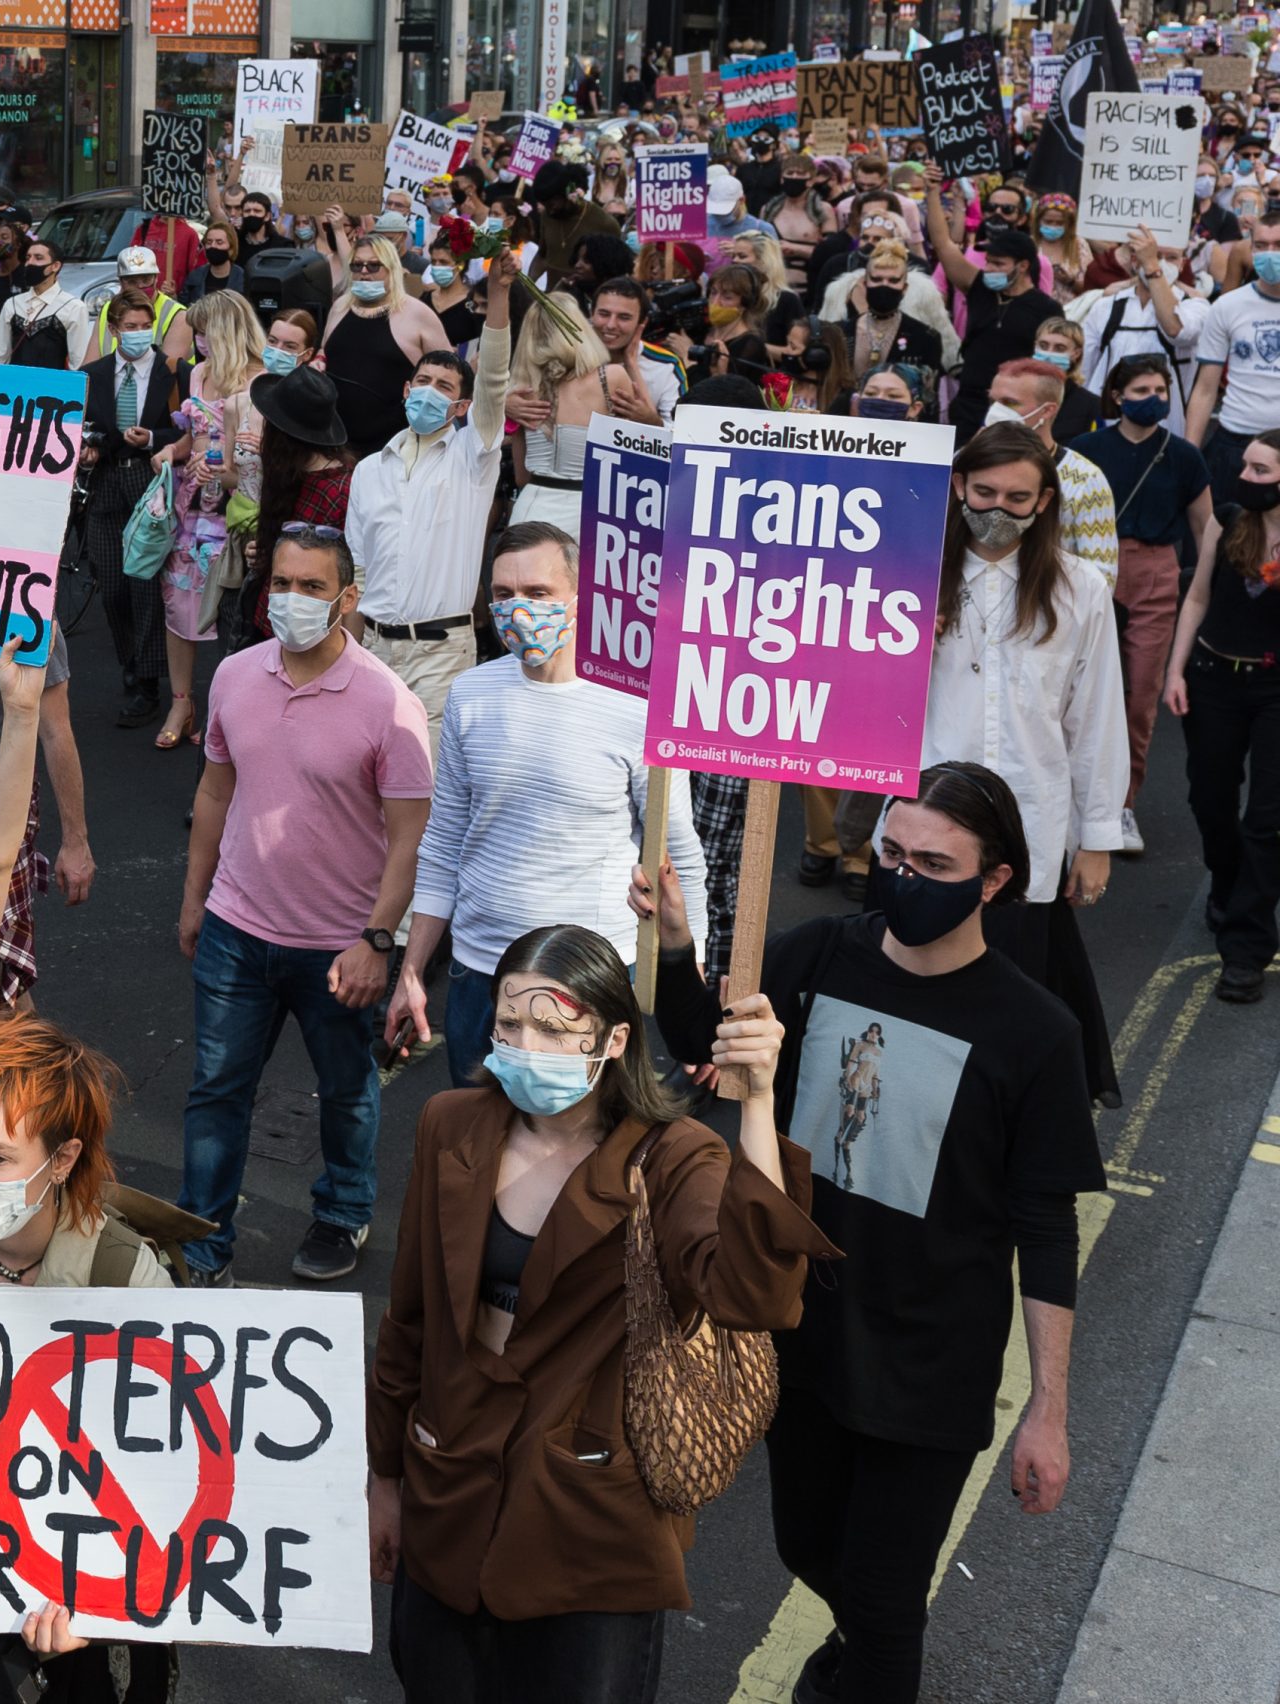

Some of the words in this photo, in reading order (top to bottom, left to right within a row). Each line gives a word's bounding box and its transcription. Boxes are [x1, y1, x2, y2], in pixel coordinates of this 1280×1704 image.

[242, 64, 304, 94] BLACK
[735, 58, 793, 80] TRANS
[797, 64, 880, 95] TRANS
[25, 94, 37, 106] OF
[176, 93, 211, 105] FLAVOURS
[212, 93, 223, 105] OF
[243, 96, 302, 114] TRANS
[733, 80, 797, 100] WOMEN
[799, 94, 857, 128] ARE
[143, 114, 203, 155] DYKES
[295, 125, 372, 143] TRANS
[398, 115, 453, 152] BLACK
[523, 119, 551, 141] Trans
[153, 150, 196, 173] FOR
[511, 151, 536, 173] Now
[517, 134, 552, 161] Rights
[142, 165, 202, 196] TRANS
[305, 164, 355, 182] ARE
[384, 166, 426, 204] LIVE
[637, 158, 692, 181] Trans
[1090, 163, 1120, 181] THE
[640, 182, 705, 212] Rights
[1088, 193, 1183, 224] PANDEMIC!
[641, 208, 682, 232] Now
[719, 421, 819, 450] Socialist
[820, 428, 906, 458] Worker
[591, 447, 669, 531] Tra
[684, 450, 883, 553] Trans
[593, 522, 662, 617] Rig
[681, 547, 922, 664] Rights
[590, 592, 656, 670] No
[594, 665, 626, 684] Socialist
[672, 643, 832, 744] Now
[677, 743, 728, 764] Socialist
[730, 749, 778, 768] Workers
[780, 754, 812, 774] Party
[838, 764, 904, 785] swp.org.uk
[50, 1319, 333, 1461] TERFS
[8, 1445, 104, 1500] ON
[45, 1512, 313, 1638] TURF
